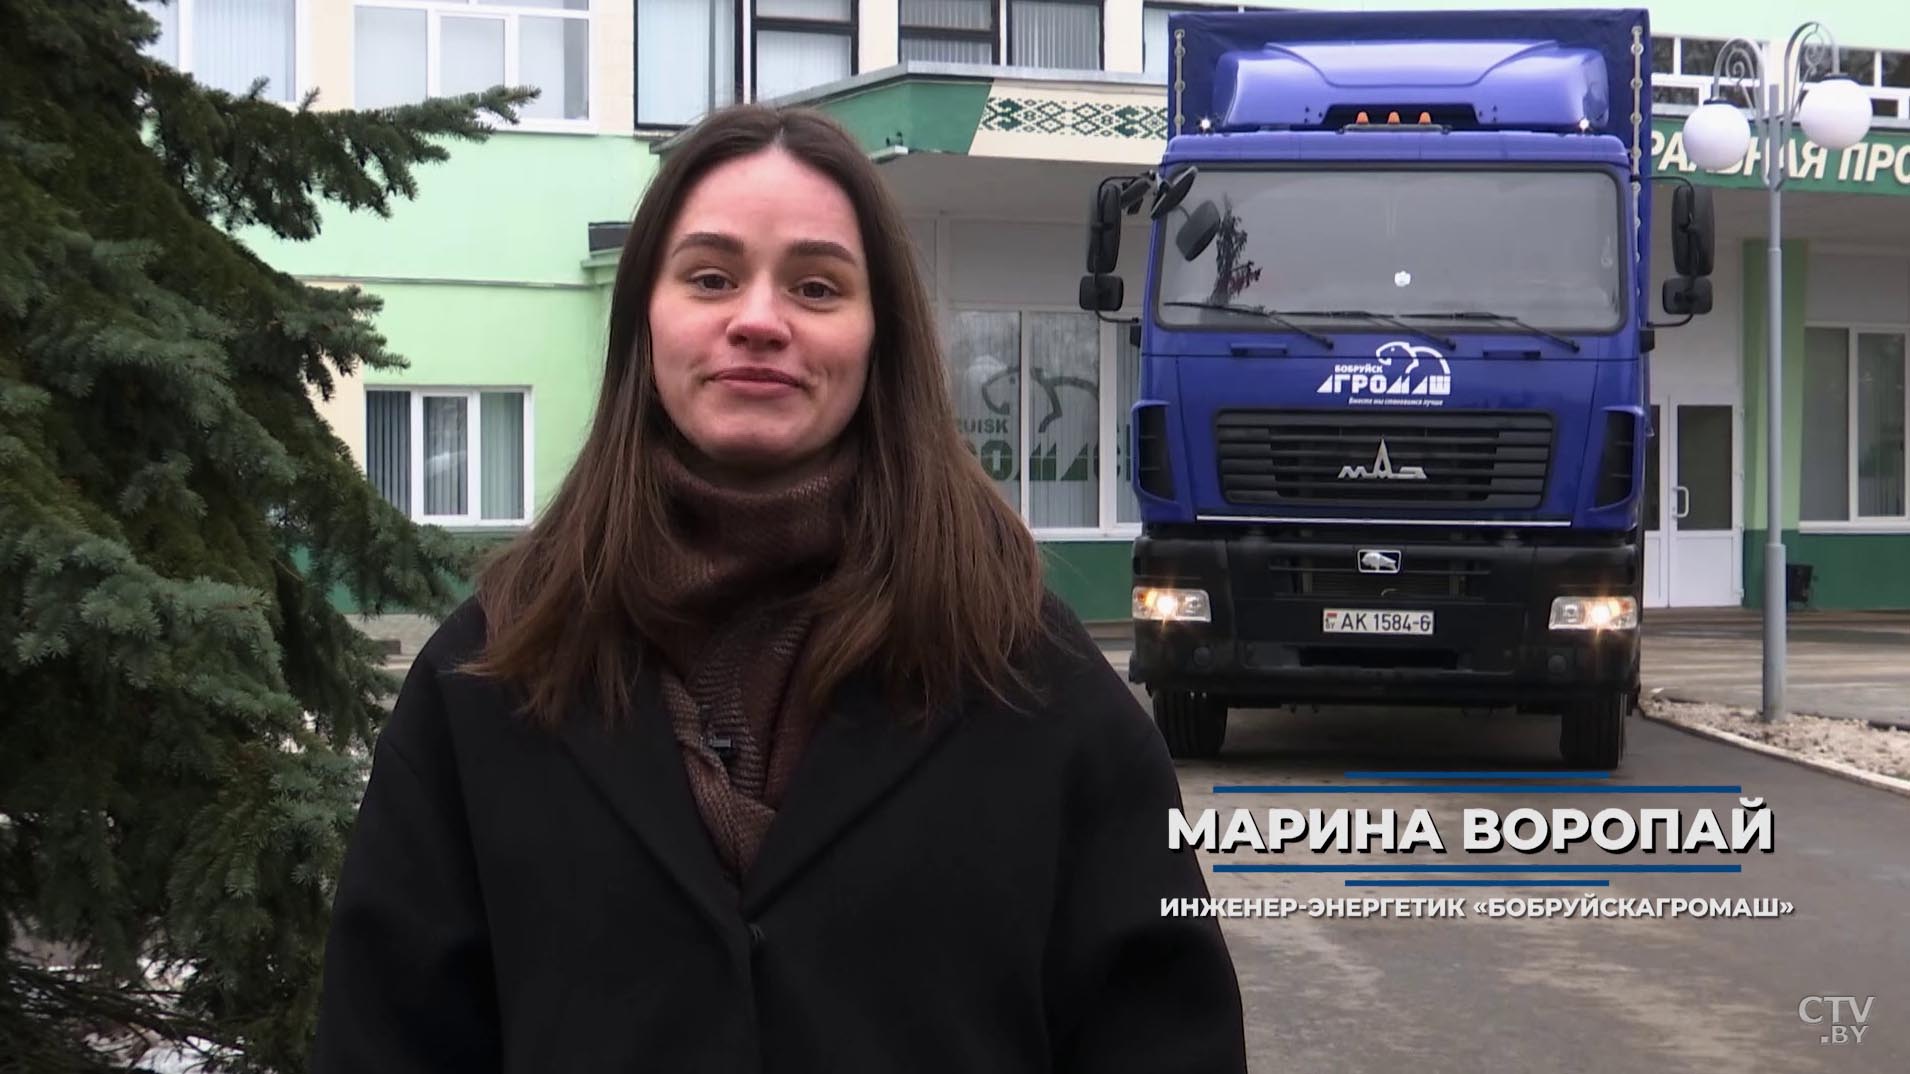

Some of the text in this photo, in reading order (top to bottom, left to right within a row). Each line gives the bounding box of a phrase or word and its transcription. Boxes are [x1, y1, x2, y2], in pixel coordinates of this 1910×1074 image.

[1334, 363, 1383, 373] БОБРУЙСК
[1316, 374, 1451, 395] АГРОМАШ
[1341, 612, 1431, 632] AK 1584-6
